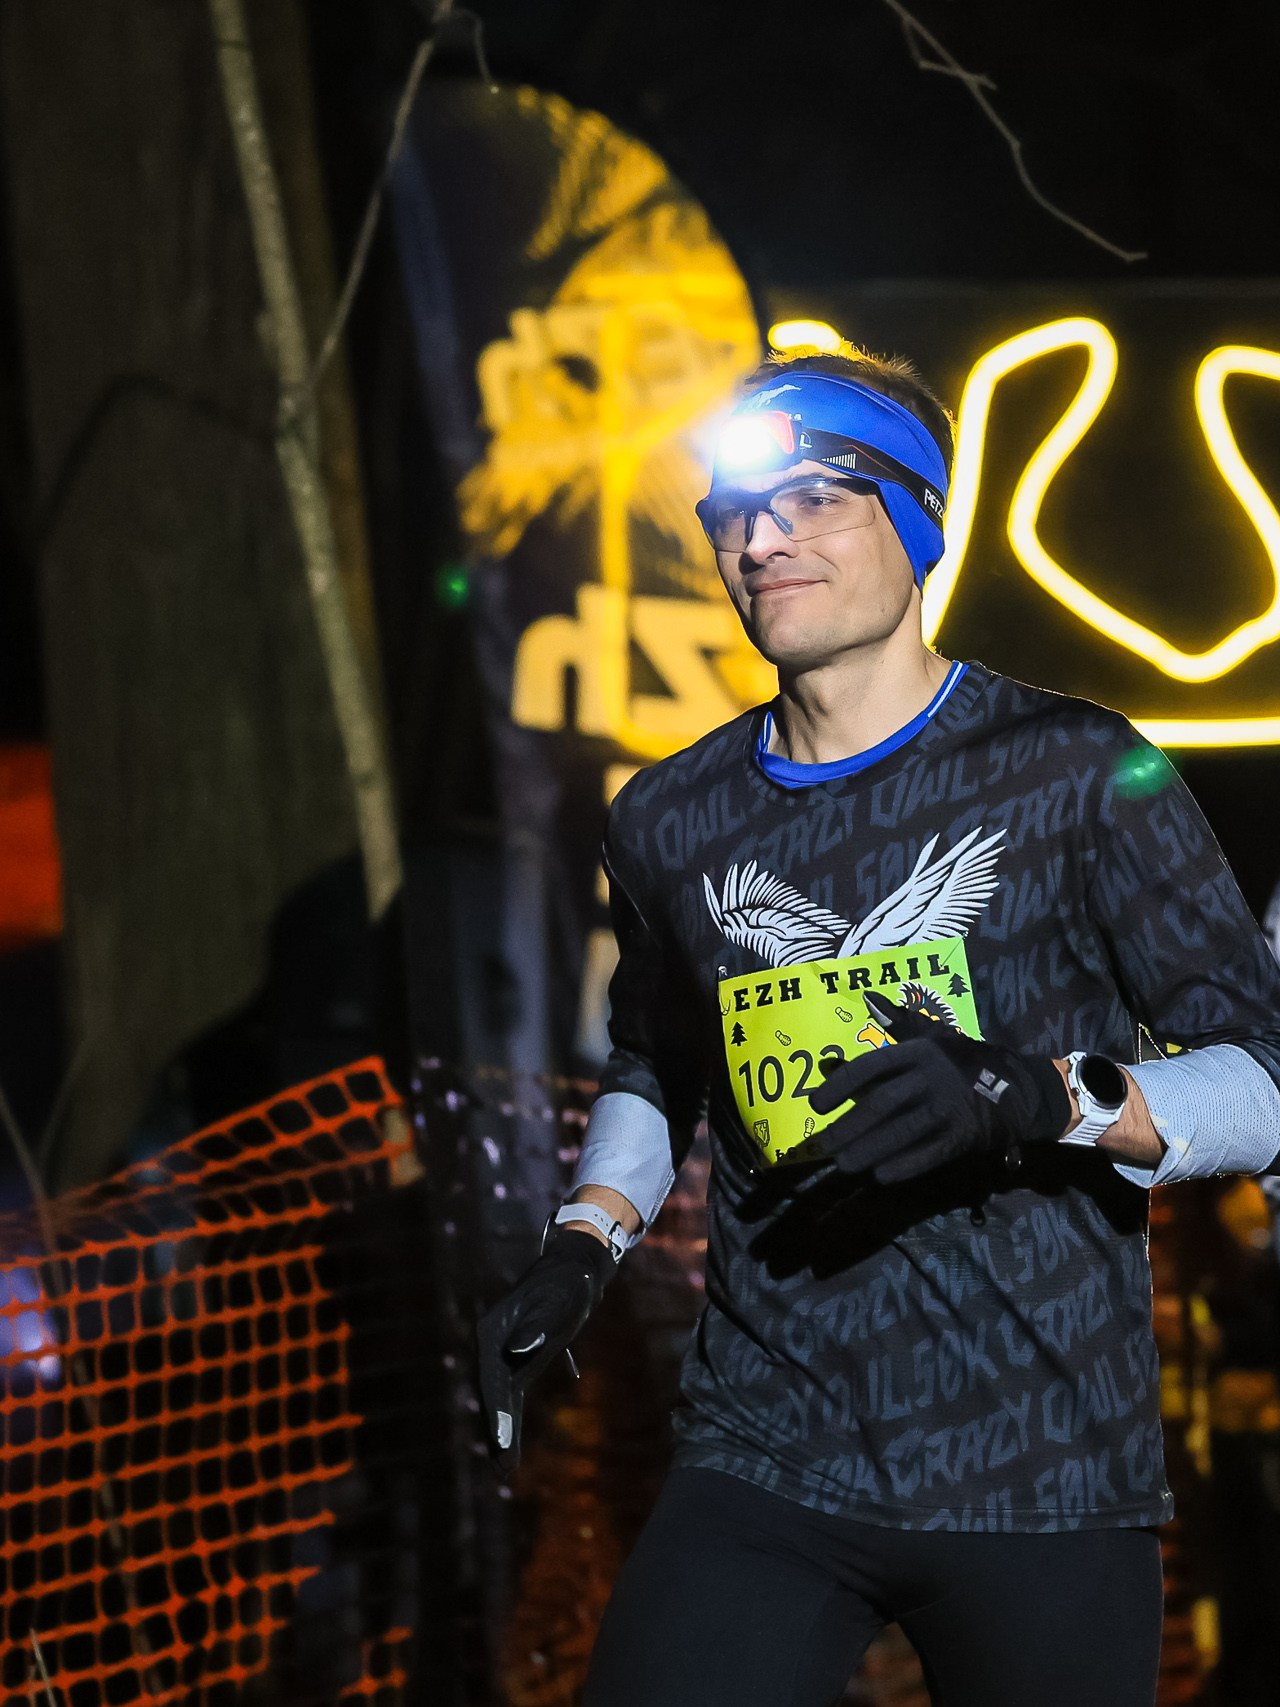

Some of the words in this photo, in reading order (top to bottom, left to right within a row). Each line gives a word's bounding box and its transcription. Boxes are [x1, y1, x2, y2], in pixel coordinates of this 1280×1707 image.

[732, 976, 803, 1013] EZH
[819, 953, 950, 995] TRAIL
[883, 1392, 1032, 1498] CRAZY
